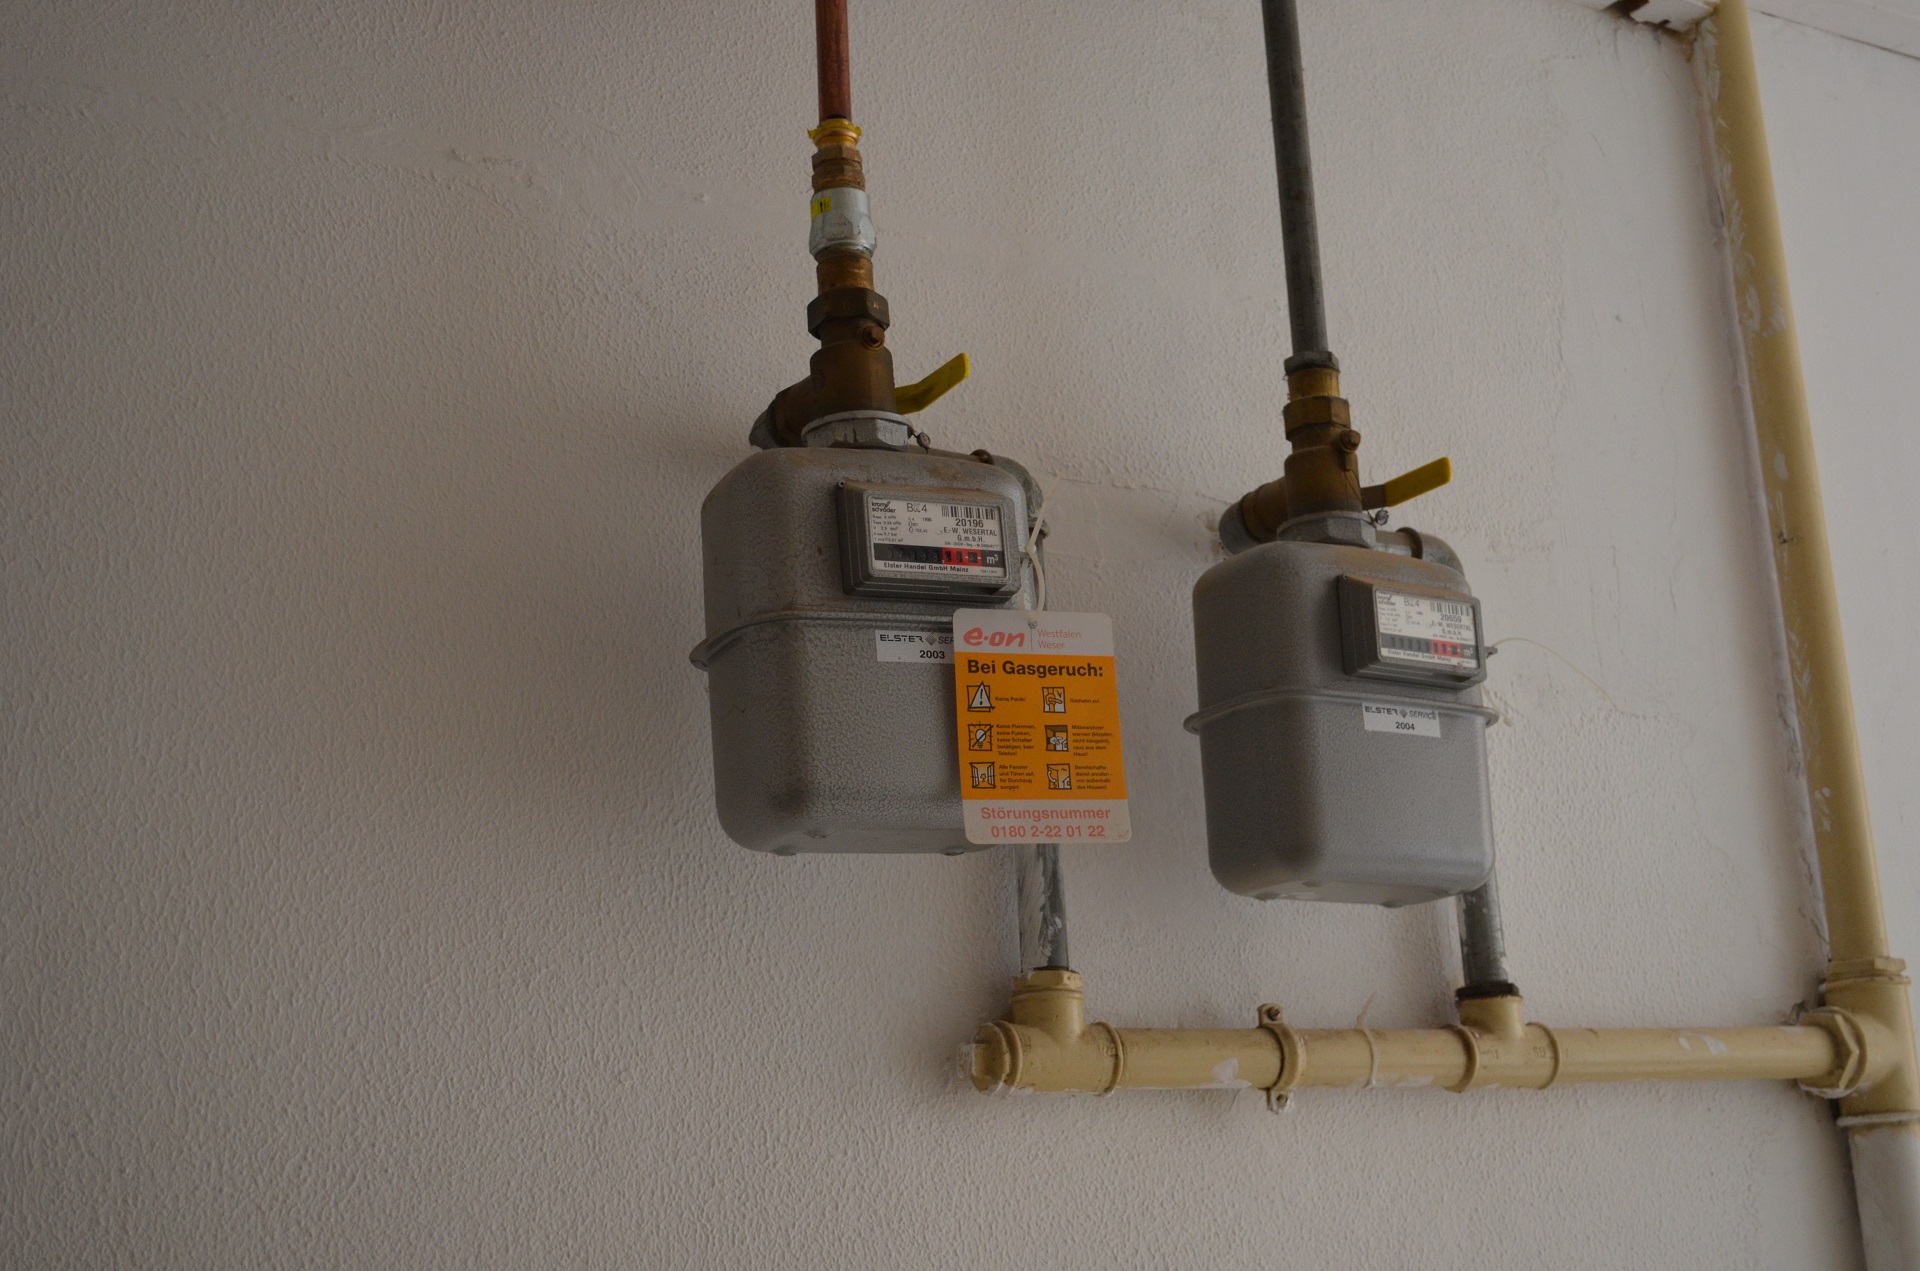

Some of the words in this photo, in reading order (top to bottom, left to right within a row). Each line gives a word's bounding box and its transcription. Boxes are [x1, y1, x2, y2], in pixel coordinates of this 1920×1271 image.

[955, 518, 984, 528] 20196
[962, 528, 997, 536] WESERTAL
[1037, 629, 1081, 638] Westfalen
[880, 634, 924, 643] ELSTER
[1037, 640, 1065, 649] Weser
[920, 650, 945, 659] 2003
[967, 659, 996, 674] Bei
[1002, 660, 1104, 678] Gasgeruch:
[1365, 706, 1398, 715] ELSTER
[1409, 710, 1437, 720] SERVICE
[1395, 721, 1415, 730] 2004
[981, 807, 1111, 822] Störungsnummer
[991, 825, 1026, 838] 0180
[1030, 825, 1062, 837] 2-22
[1066, 825, 1081, 837] 01
[1088, 825, 1105, 837] 22
